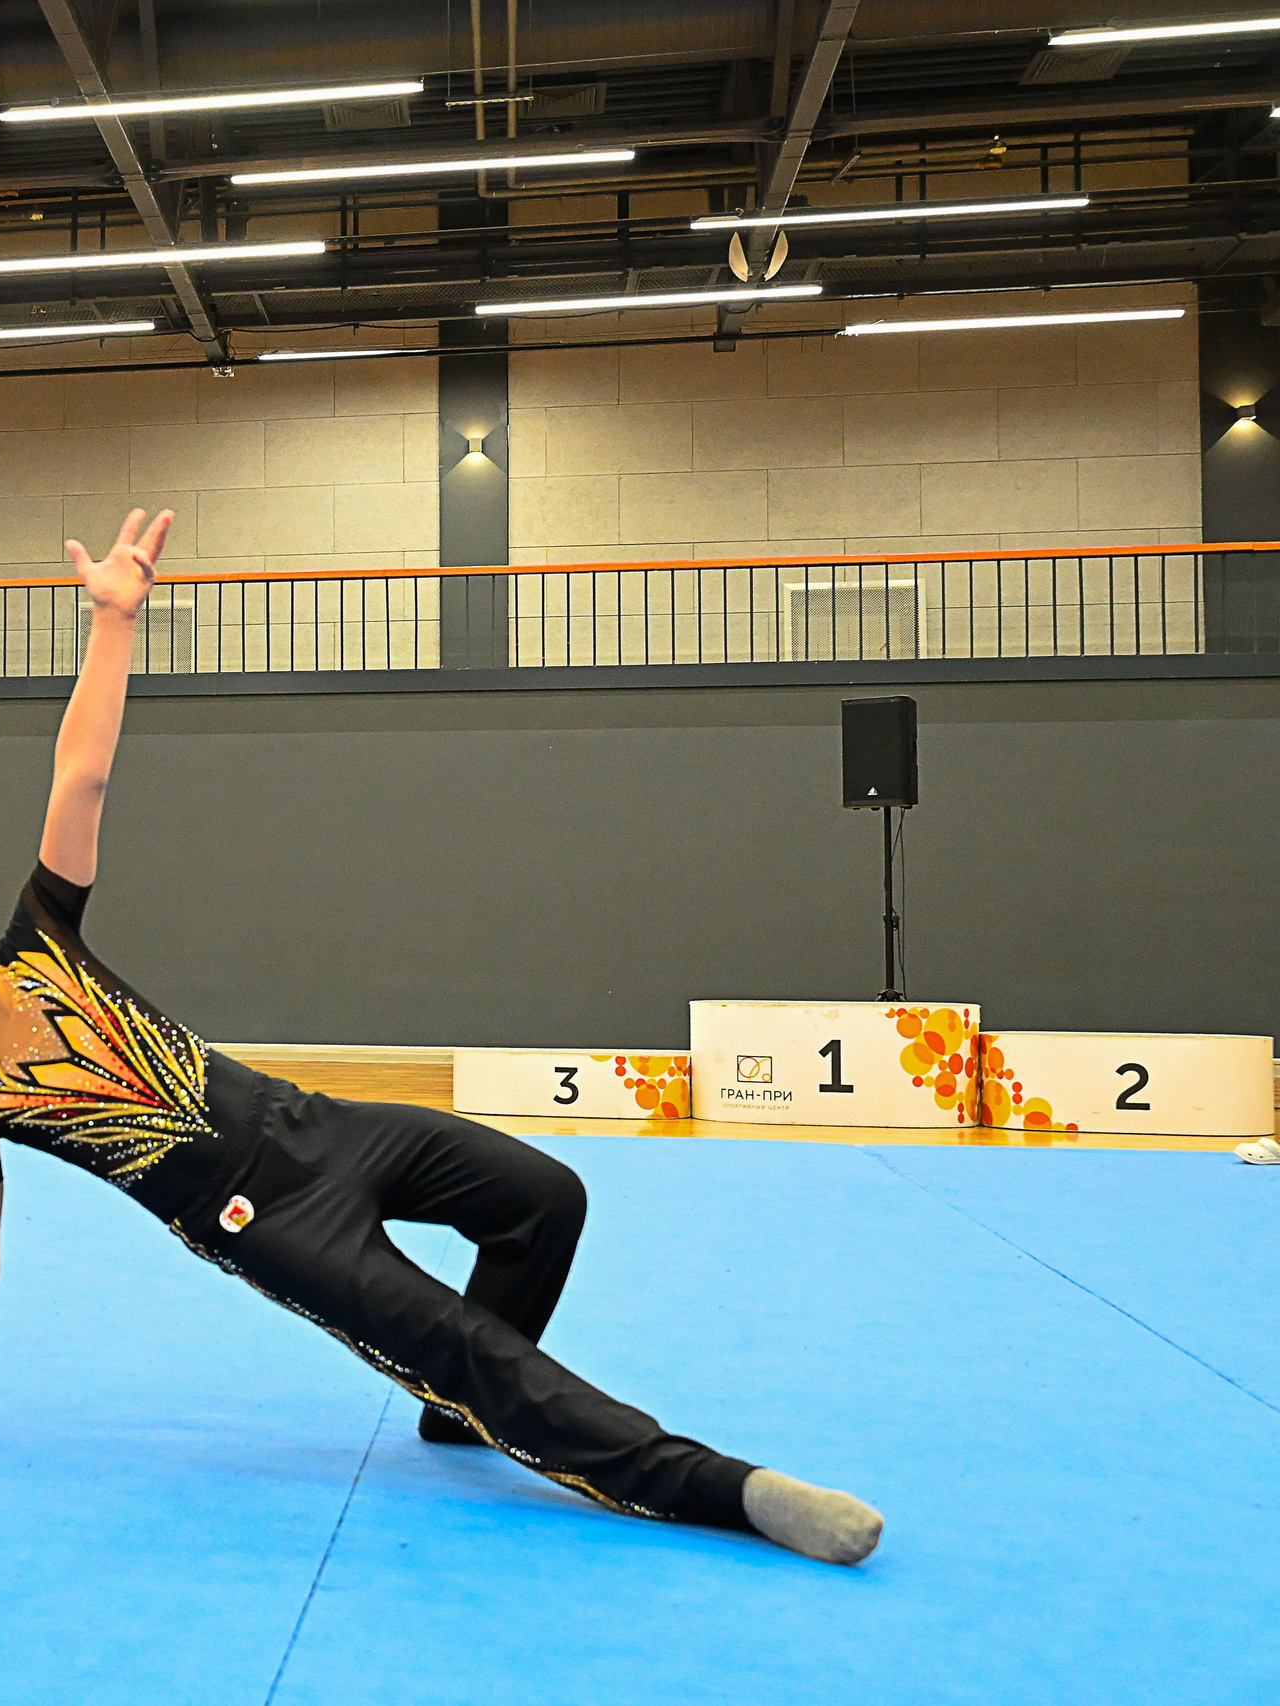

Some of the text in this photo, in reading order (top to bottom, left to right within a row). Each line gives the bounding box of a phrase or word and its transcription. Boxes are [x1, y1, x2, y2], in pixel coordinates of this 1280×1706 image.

[552, 1066, 580, 1105] 3
[818, 1039, 854, 1094] 1
[1115, 1062, 1151, 1111] 2
[720, 1088, 793, 1102] ГРАН-ПРИ
